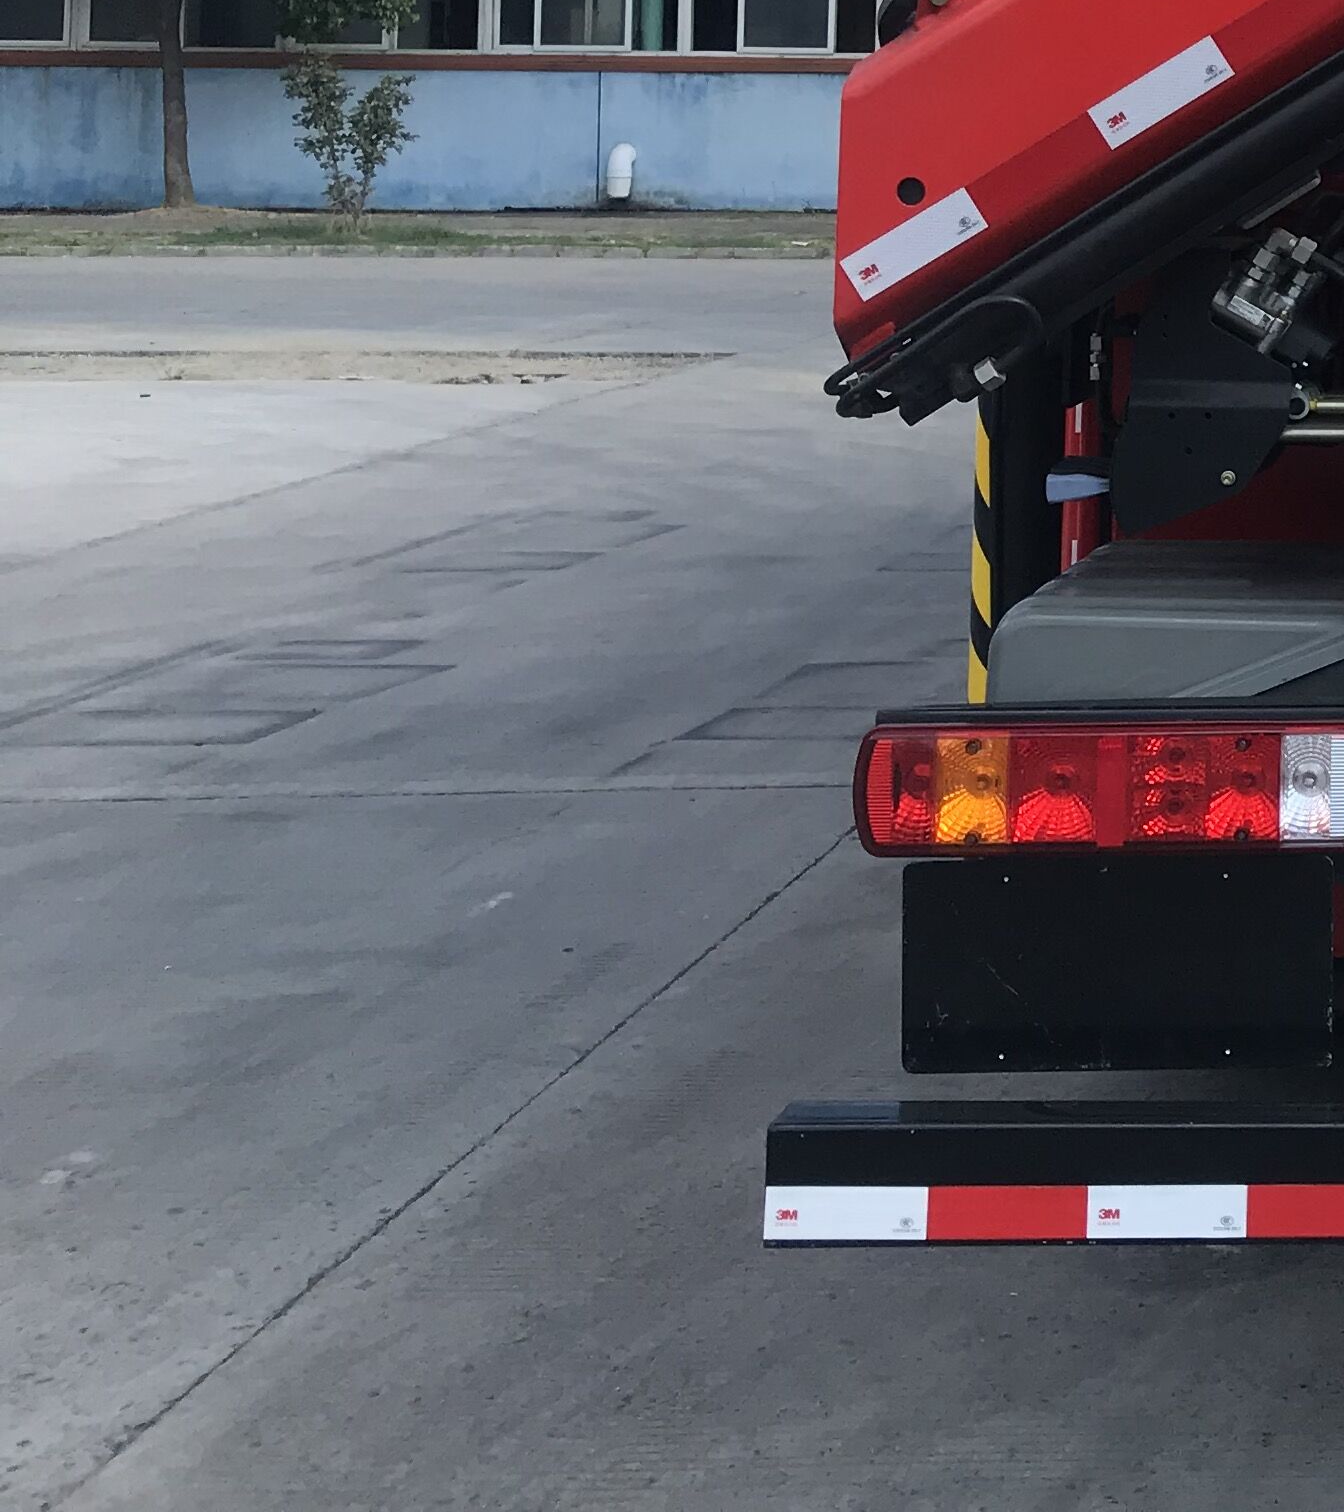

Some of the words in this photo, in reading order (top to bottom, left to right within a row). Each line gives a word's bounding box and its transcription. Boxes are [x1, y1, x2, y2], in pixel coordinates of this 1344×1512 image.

[1108, 112, 1127, 128] 3M
[859, 264, 878, 280] 3M
[776, 1209, 798, 1221] 3M
[1098, 1208, 1121, 1220] 3M
